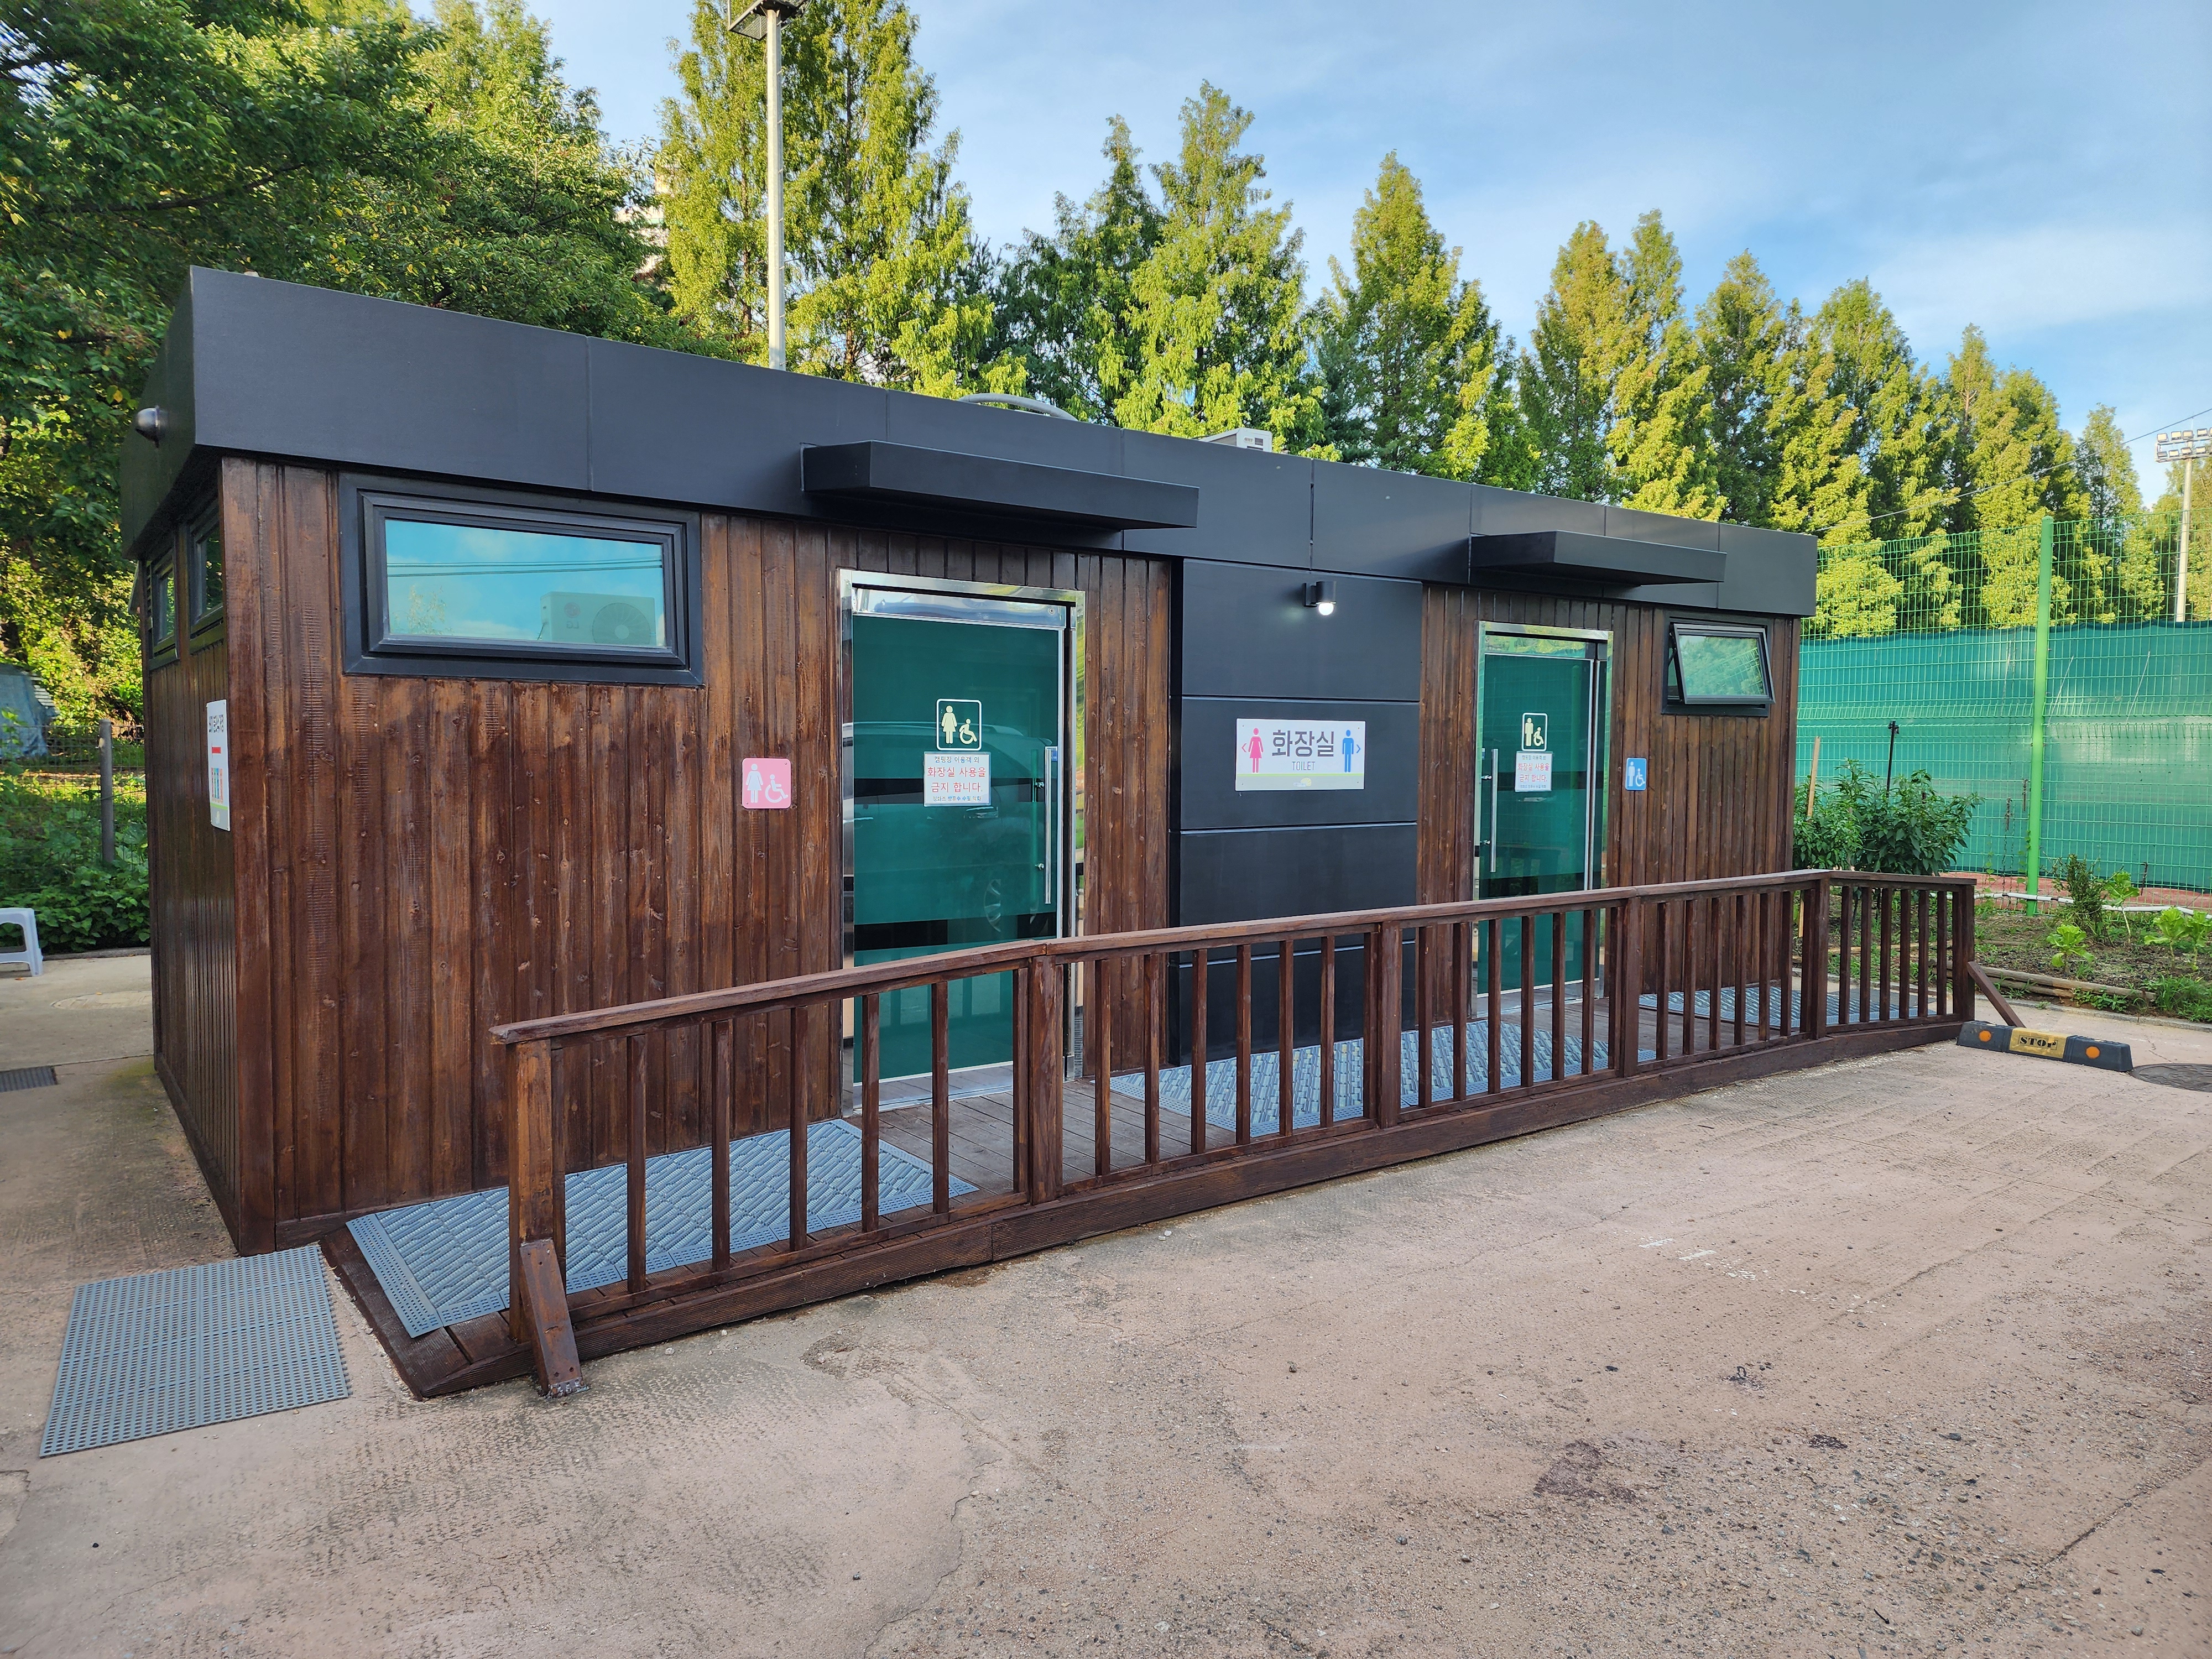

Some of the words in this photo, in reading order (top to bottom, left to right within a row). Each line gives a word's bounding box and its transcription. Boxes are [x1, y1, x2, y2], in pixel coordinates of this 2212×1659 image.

[1271, 729, 1334, 757] 화장실
[927, 766, 955, 778] 화장실
[959, 766, 986, 778] 사용을
[1292, 761, 1316, 771] TOILET
[1518, 763, 1533, 771] 화장실
[1535, 763, 1550, 771] 사용을
[1531, 774, 1548, 782] 합니다.
[931, 782, 949, 793] 금지
[953, 781, 983, 793] 합니다.
[2020, 1036, 2057, 1048] STOP
